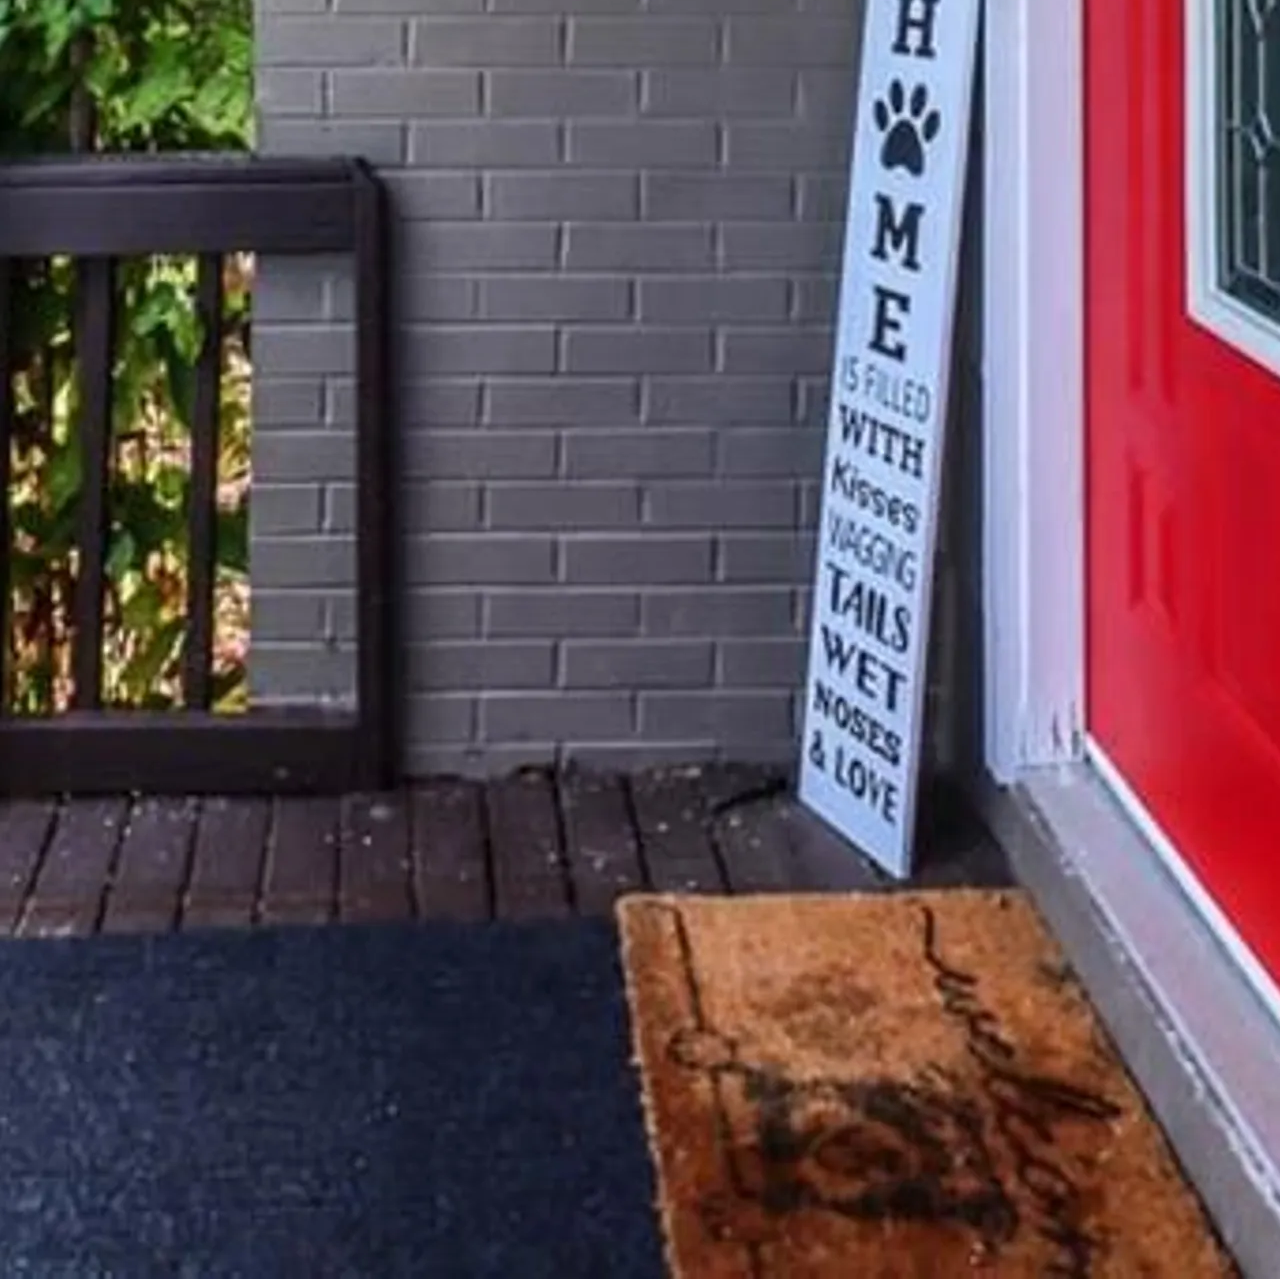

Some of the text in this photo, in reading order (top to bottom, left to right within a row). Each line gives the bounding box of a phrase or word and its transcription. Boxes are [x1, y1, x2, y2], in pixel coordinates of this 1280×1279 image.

[864, 365, 932, 423] FILLED
[837, 405, 925, 479] WITH
[832, 456, 920, 534] Kisses
[827, 515, 918, 593] WAGGING
[825, 562, 911, 655] TAILS
[820, 624, 908, 712] WET
[813, 681, 903, 767] NOSES
[808, 730, 898, 824] & LOVE
